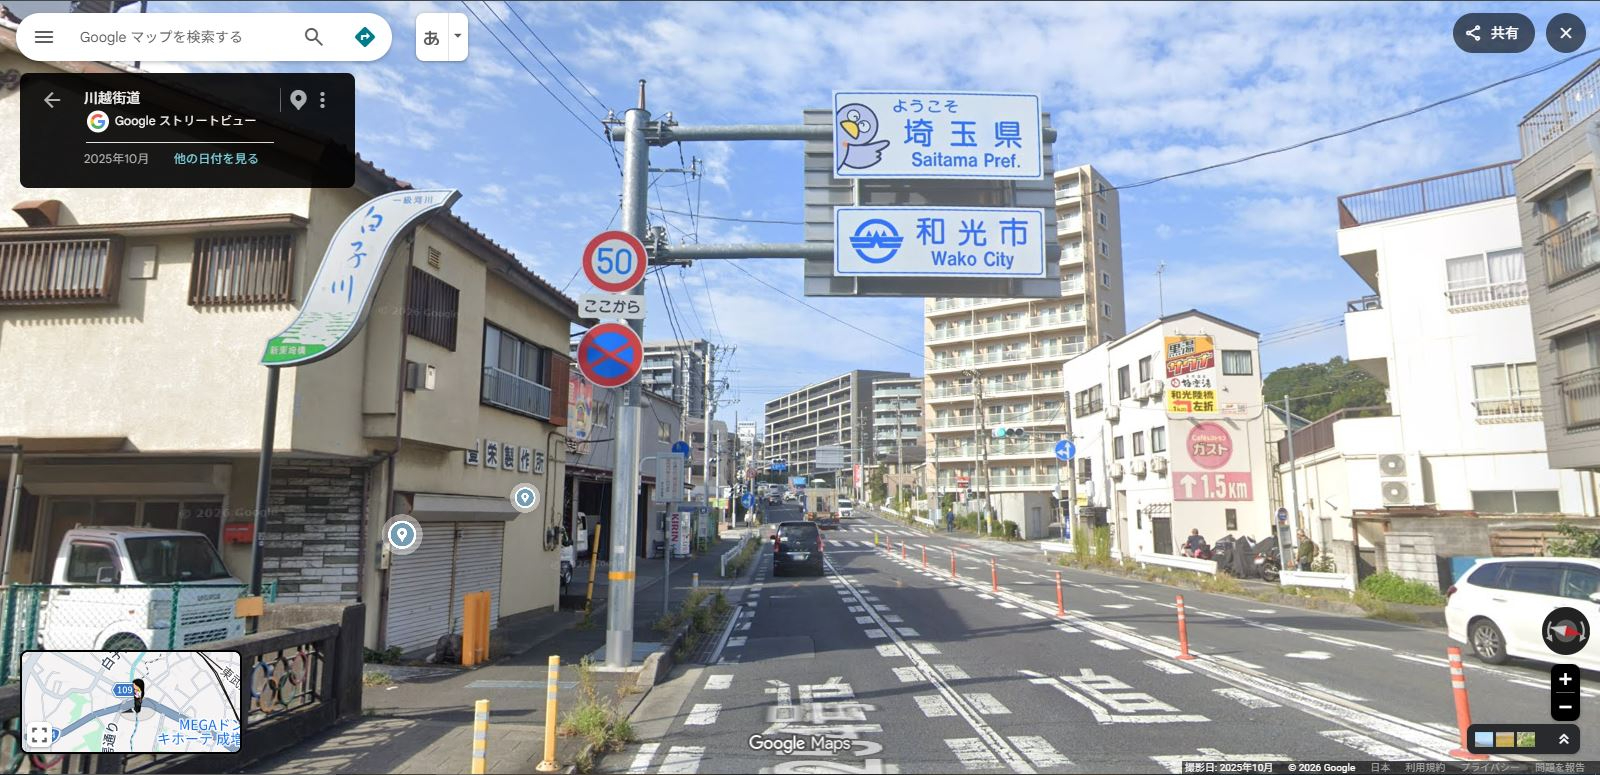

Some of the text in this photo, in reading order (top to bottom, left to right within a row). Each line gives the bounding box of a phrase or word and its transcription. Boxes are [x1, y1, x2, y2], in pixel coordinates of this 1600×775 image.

[893, 98, 959, 114] ようこそ
[903, 118, 1023, 149] 埼玉県
[912, 151, 1021, 168] Saitama Pref.
[393, 195, 433, 205] 一級河川
[916, 217, 1029, 247] 和光市
[331, 205, 384, 303] 白子川
[597, 247, 632, 275] 50
[931, 251, 1014, 270] Wako City
[584, 299, 641, 314] ここから
[1171, 390, 1214, 400] 和光陸橋
[1193, 401, 1214, 412] 左折
[1193, 443, 1228, 456] ガスト
